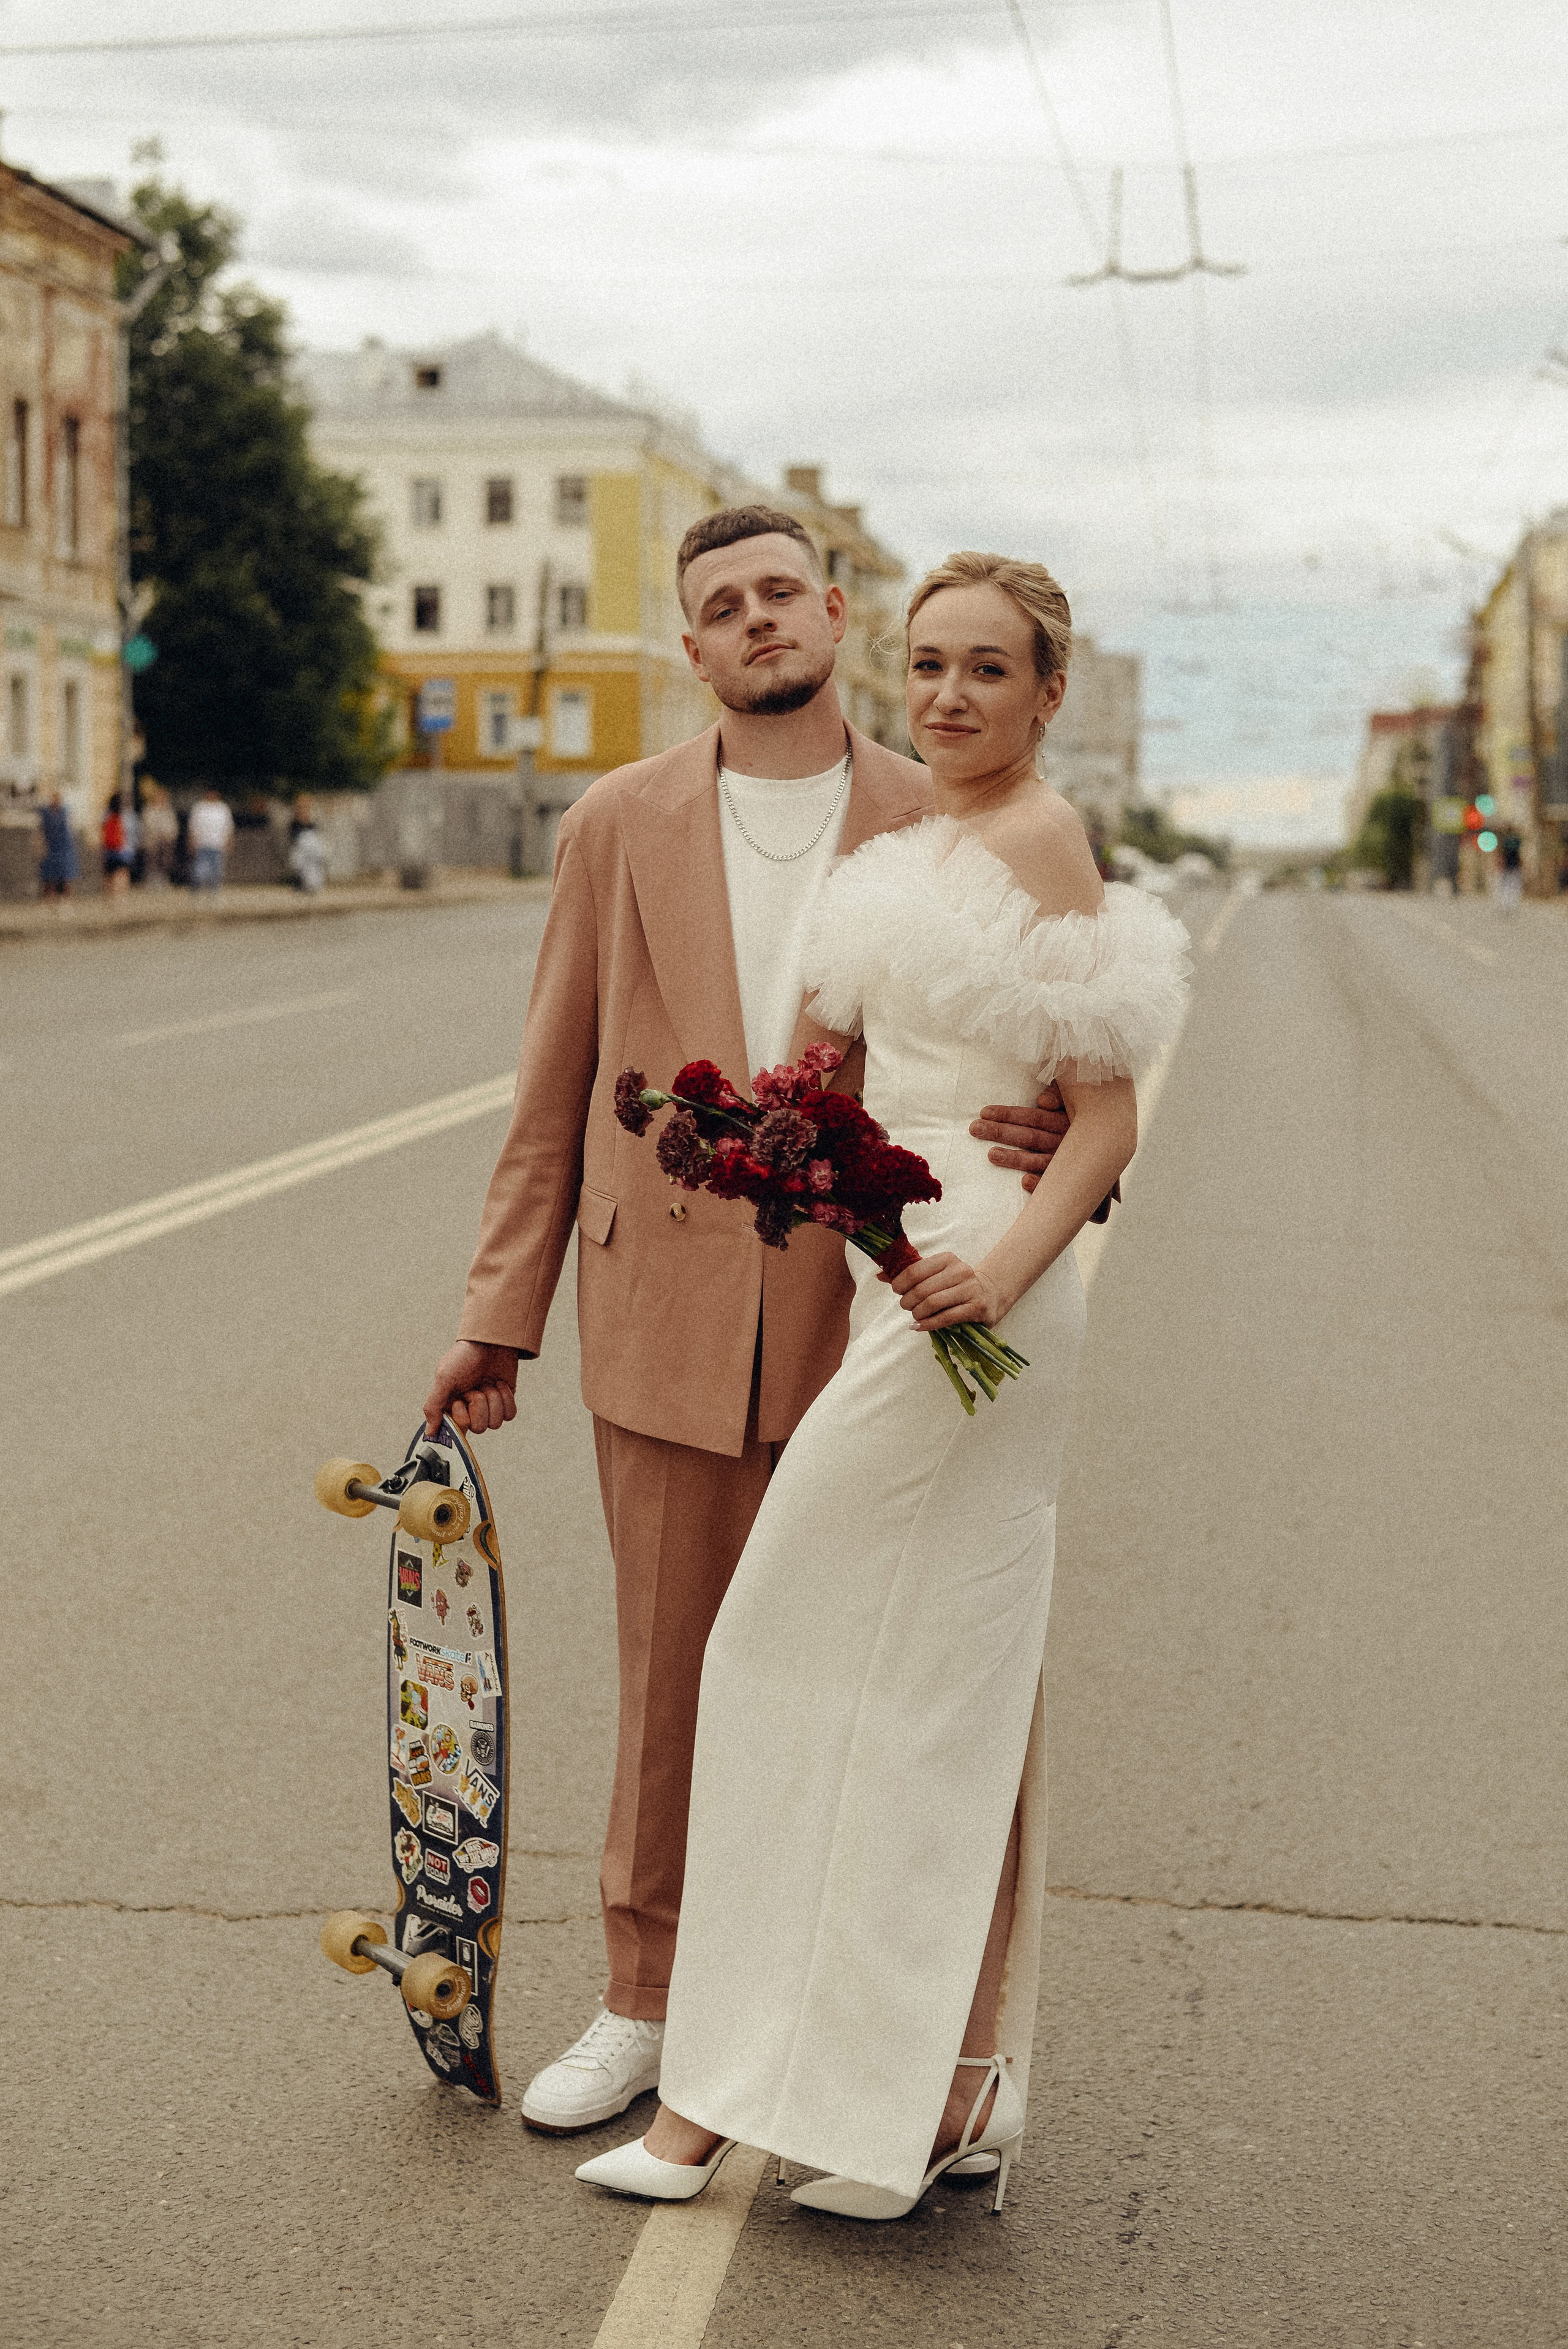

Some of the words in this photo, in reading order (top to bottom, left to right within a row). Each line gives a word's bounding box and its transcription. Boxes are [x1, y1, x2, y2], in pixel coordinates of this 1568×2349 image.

[399, 1566, 421, 1590] VANS
[410, 1637, 441, 1656] FOOTWORK
[416, 1653, 454, 1691] VANS
[470, 1721, 494, 1732] RAMONES
[466, 1758, 498, 1808] VANS
[428, 1853, 448, 1873] NOT
[427, 1865, 448, 1882] TODAY
